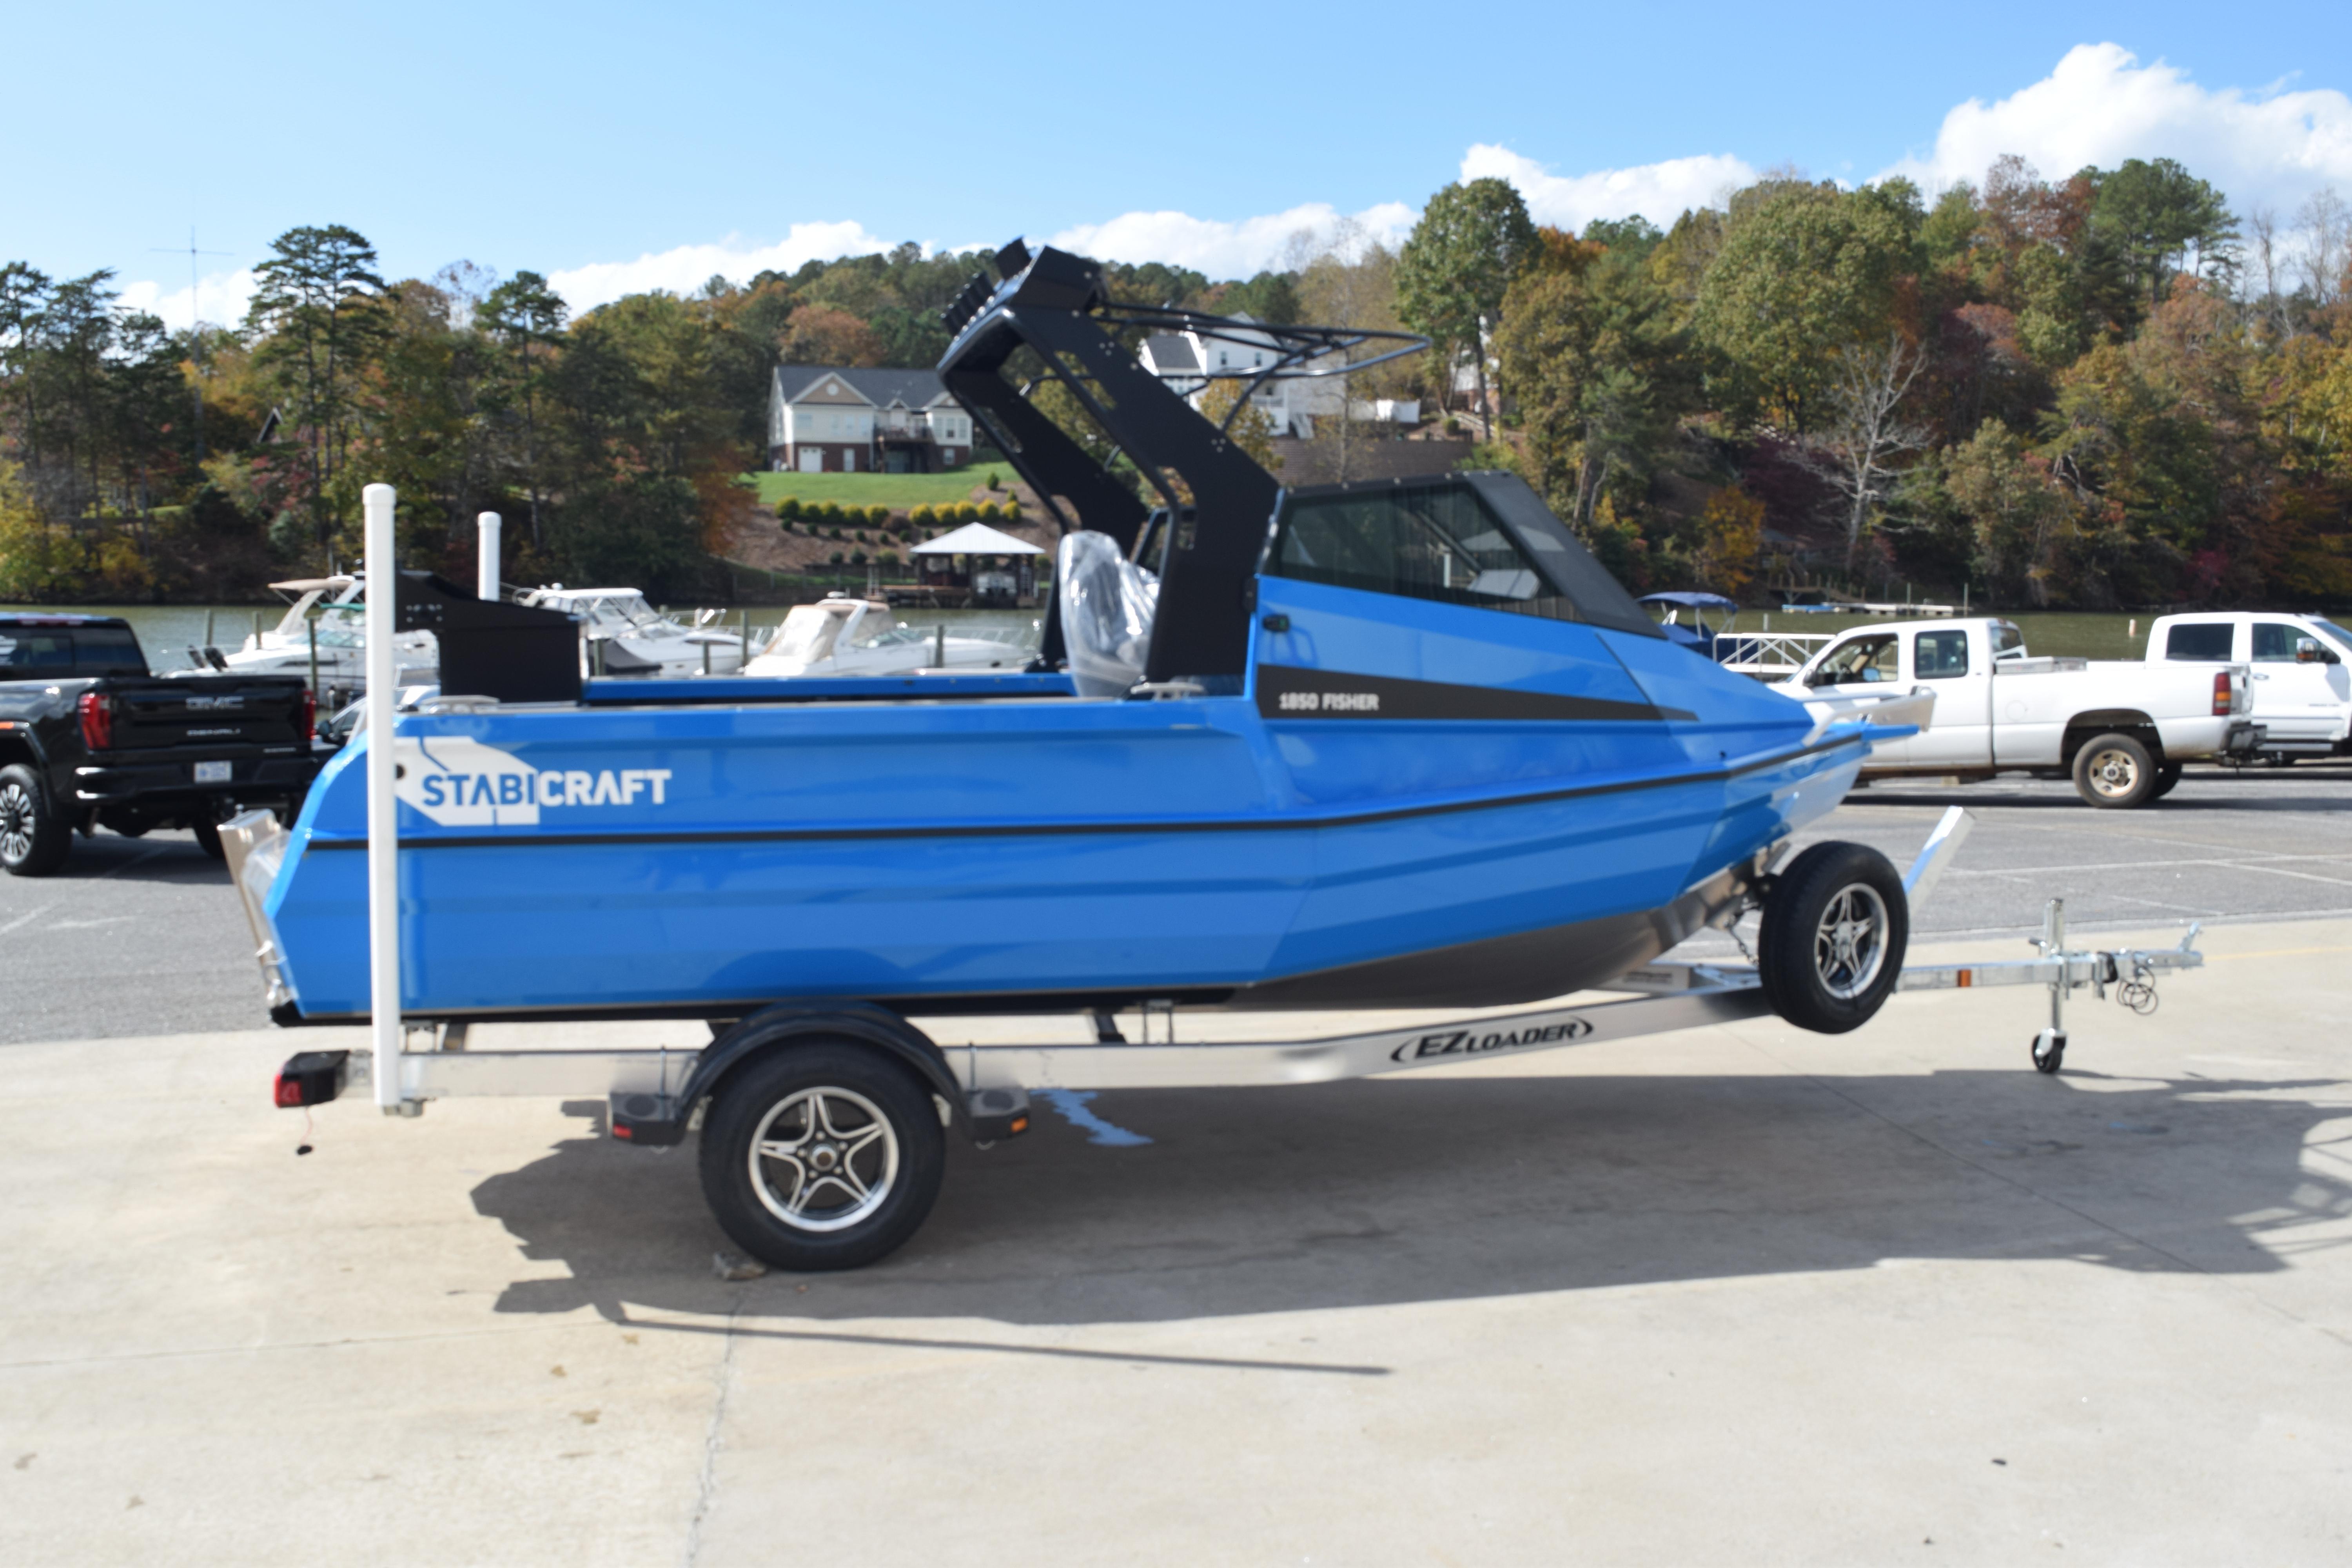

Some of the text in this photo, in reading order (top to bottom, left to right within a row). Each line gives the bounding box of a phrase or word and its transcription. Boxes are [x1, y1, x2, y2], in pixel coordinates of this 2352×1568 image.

[186, 696, 245, 710] GMC
[1279, 692, 1379, 710] 1850 FISHER
[422, 769, 672, 806] STABICRAFT
